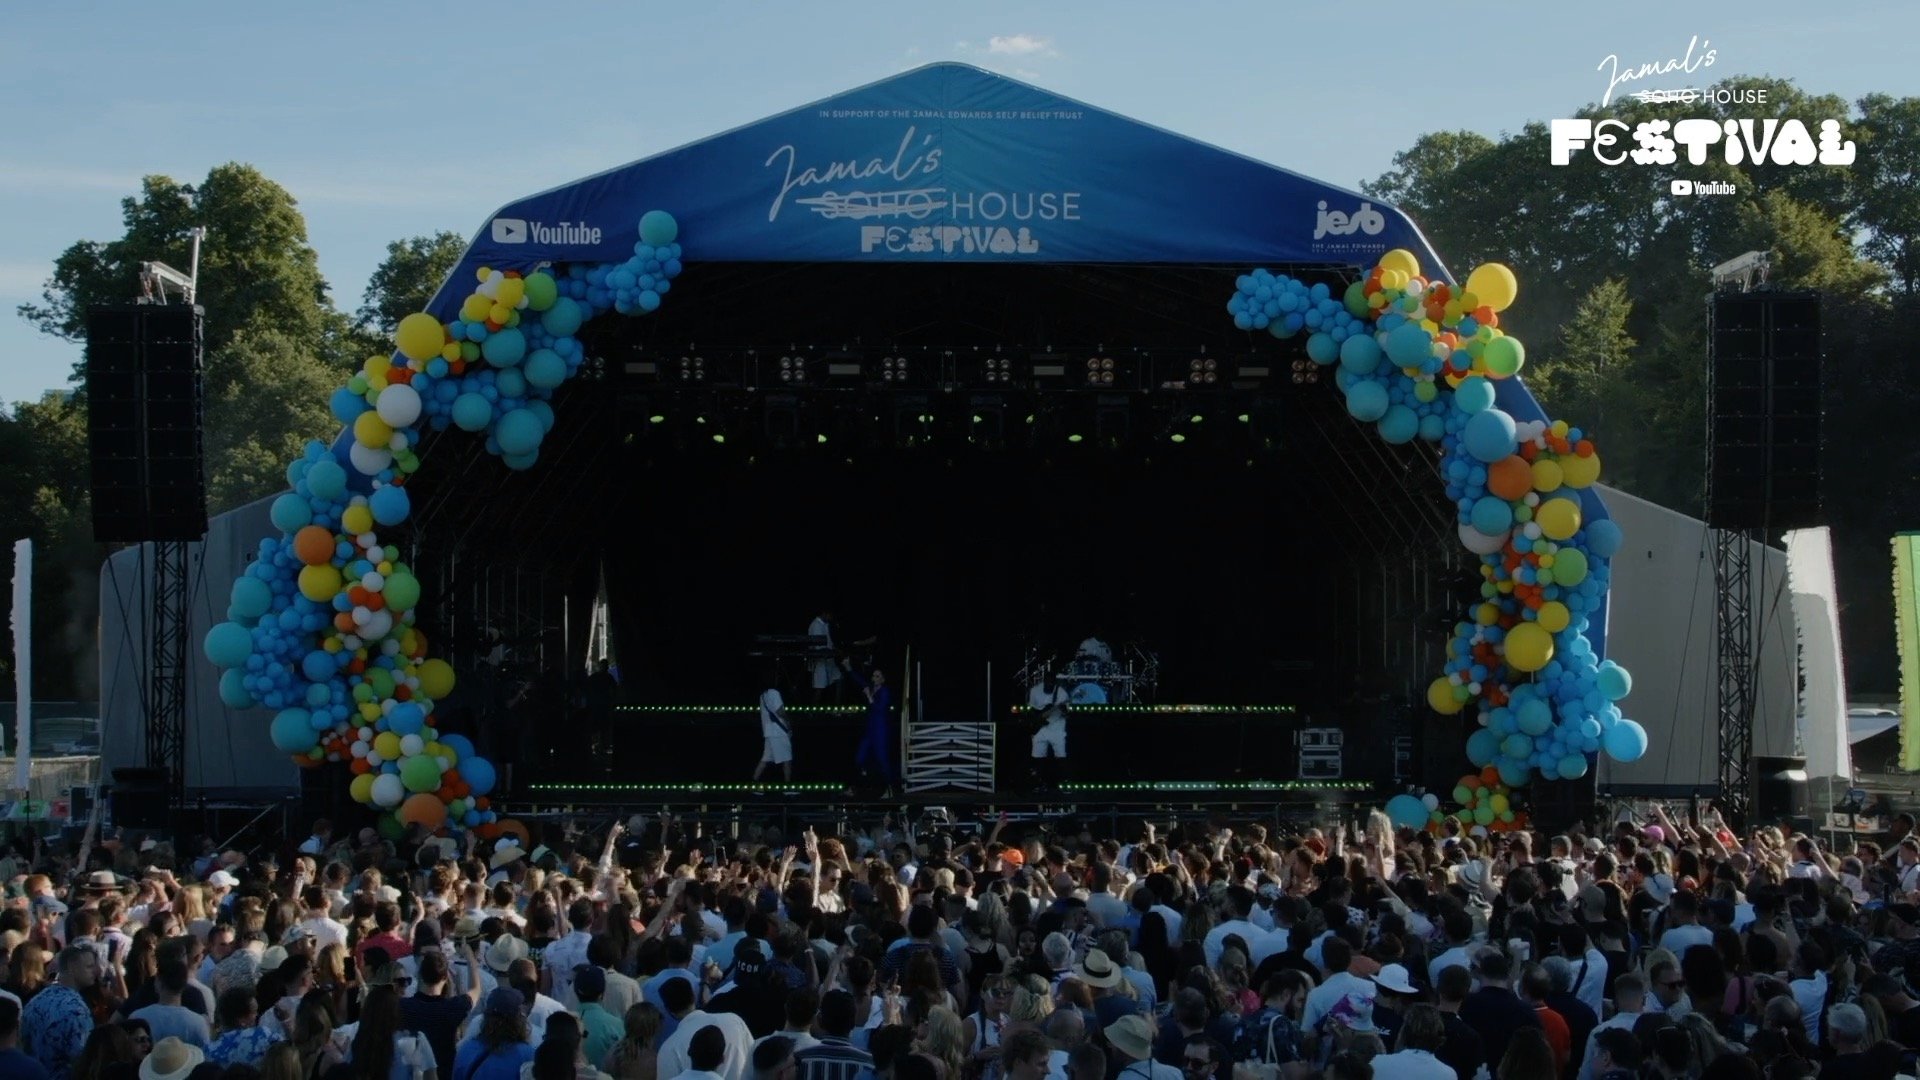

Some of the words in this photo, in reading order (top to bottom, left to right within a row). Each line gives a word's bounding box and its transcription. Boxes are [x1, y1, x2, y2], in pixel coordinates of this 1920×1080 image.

[819, 110, 829, 118] IN
[832, 110, 875, 118] SUPPORT
[877, 110, 889, 118] OF
[892, 110, 910, 118] THE
[913, 110, 945, 119] JAMAL
[948, 111, 993, 119] EDWARDS
[996, 111, 1018, 119] SELF
[1020, 111, 1050, 120] BELIEF
[1054, 111, 1084, 120] TRUST
[765, 125, 942, 223] Jamal's
[820, 190, 933, 220] SOHO
[952, 192, 1082, 221] HOUSE
[529, 221, 602, 245] YouTube
[737, 960, 759, 973] ICON
